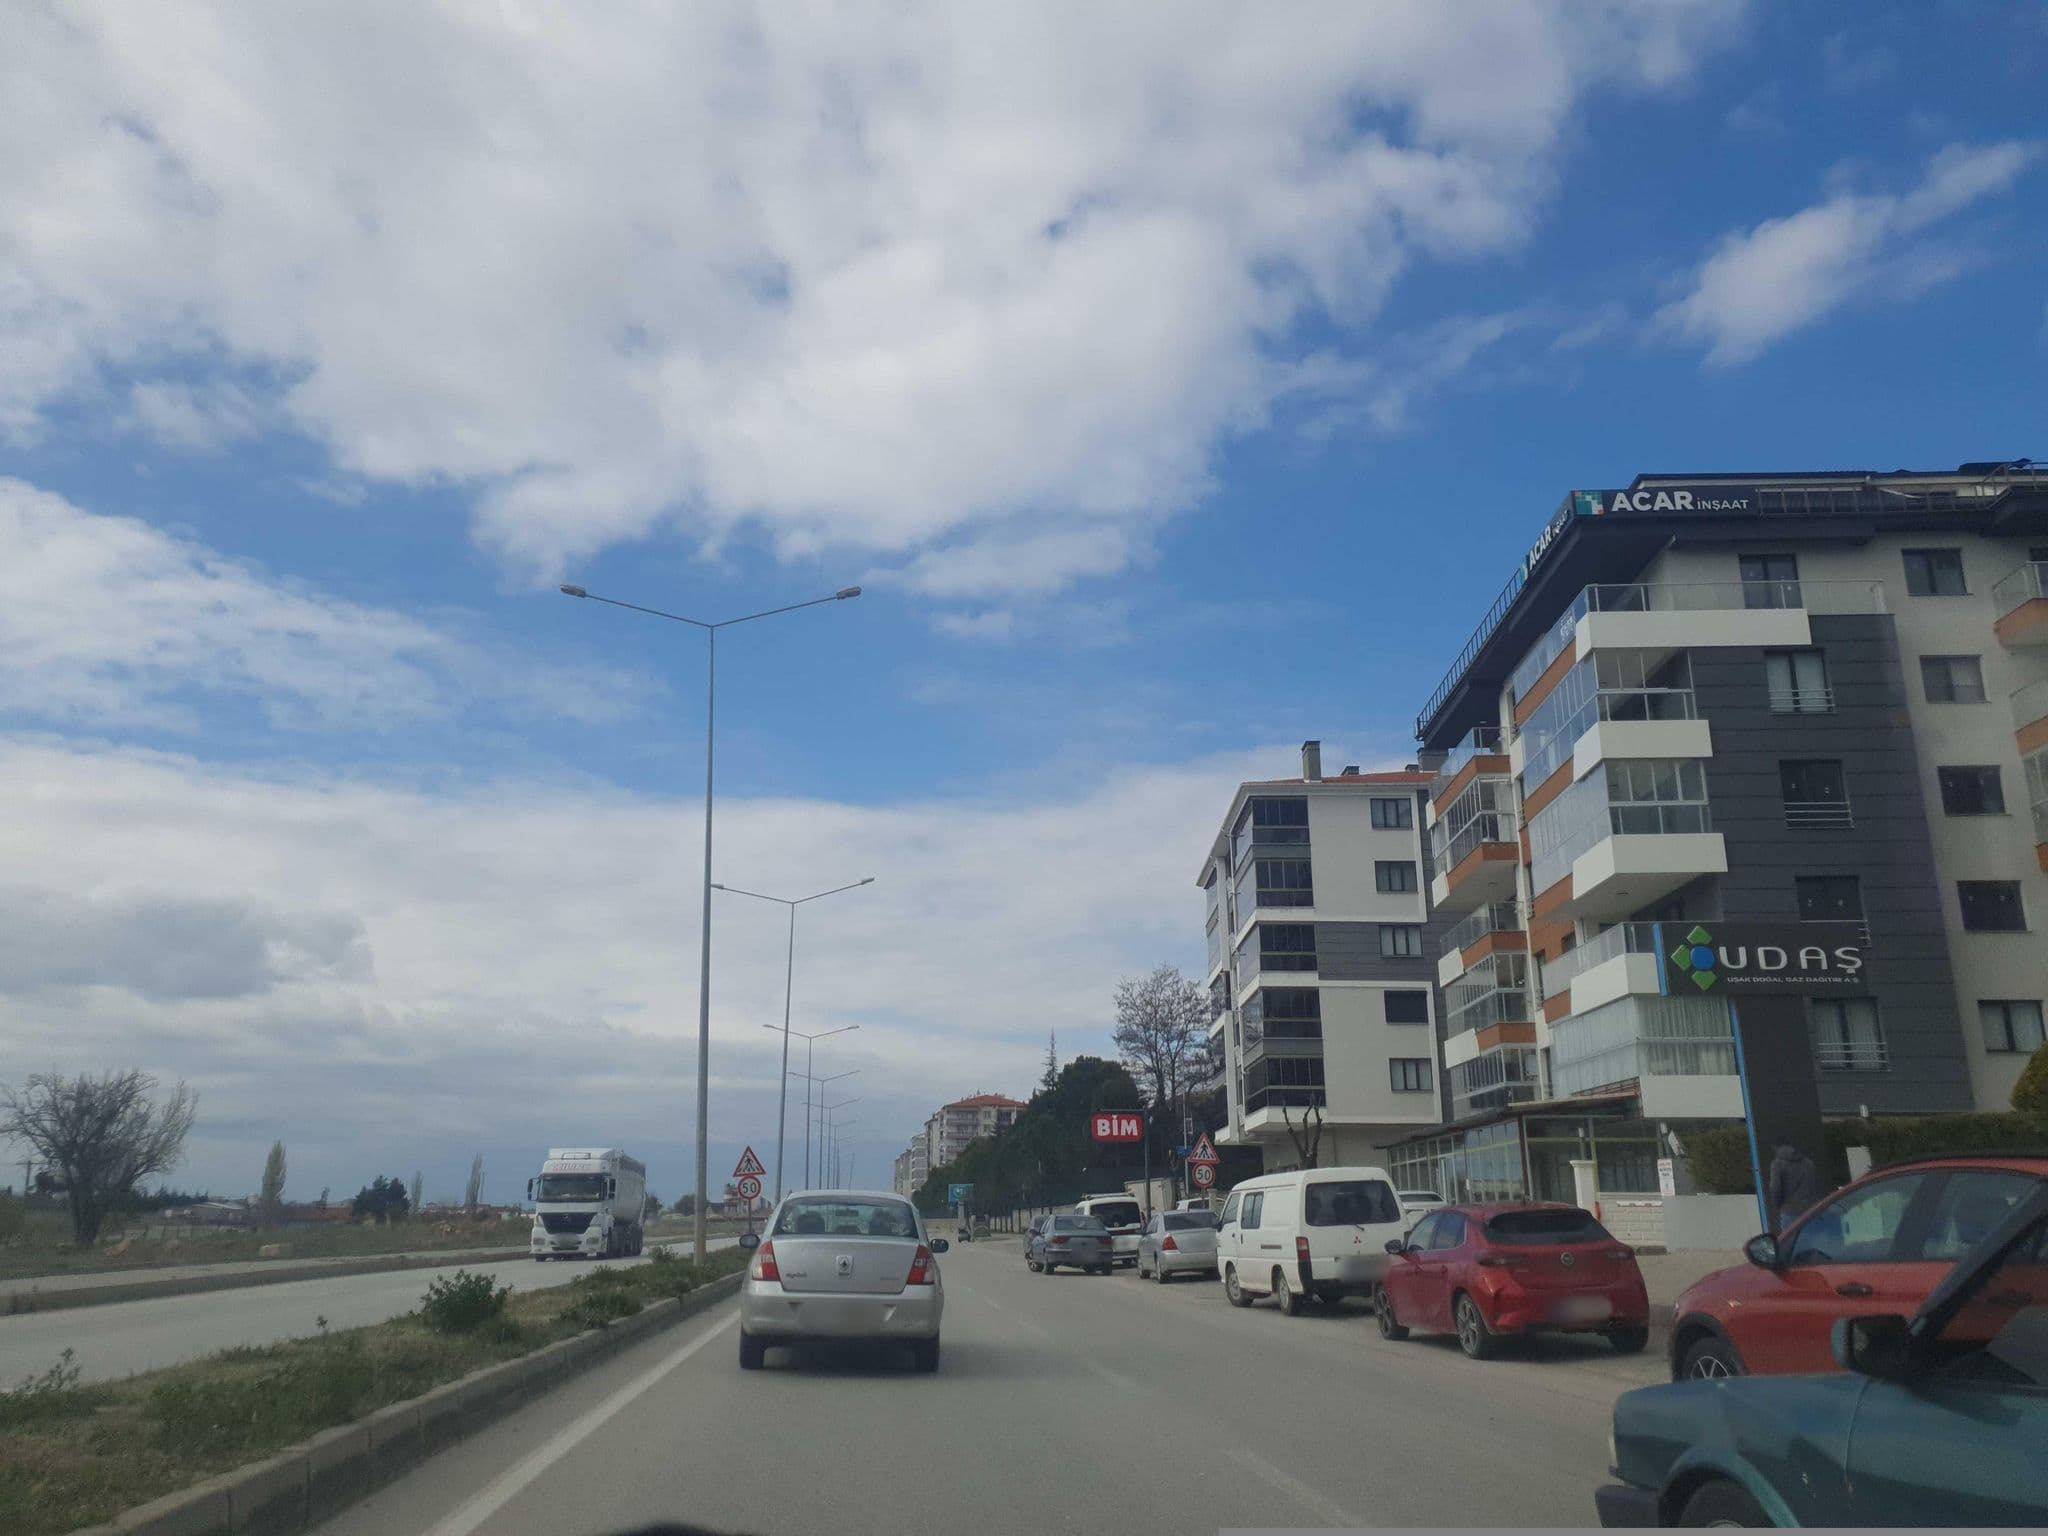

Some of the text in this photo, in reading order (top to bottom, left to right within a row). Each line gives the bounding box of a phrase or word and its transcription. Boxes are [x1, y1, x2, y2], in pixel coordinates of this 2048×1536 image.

[1611, 490, 1749, 512] ACAR İNŞAAT
[1529, 525, 1552, 570] ACAR
[1718, 946, 1863, 973] UDAŞ
[1096, 1114, 1138, 1136] BİM
[1197, 1170, 1211, 1181] 50
[742, 1181, 757, 1194] 50
